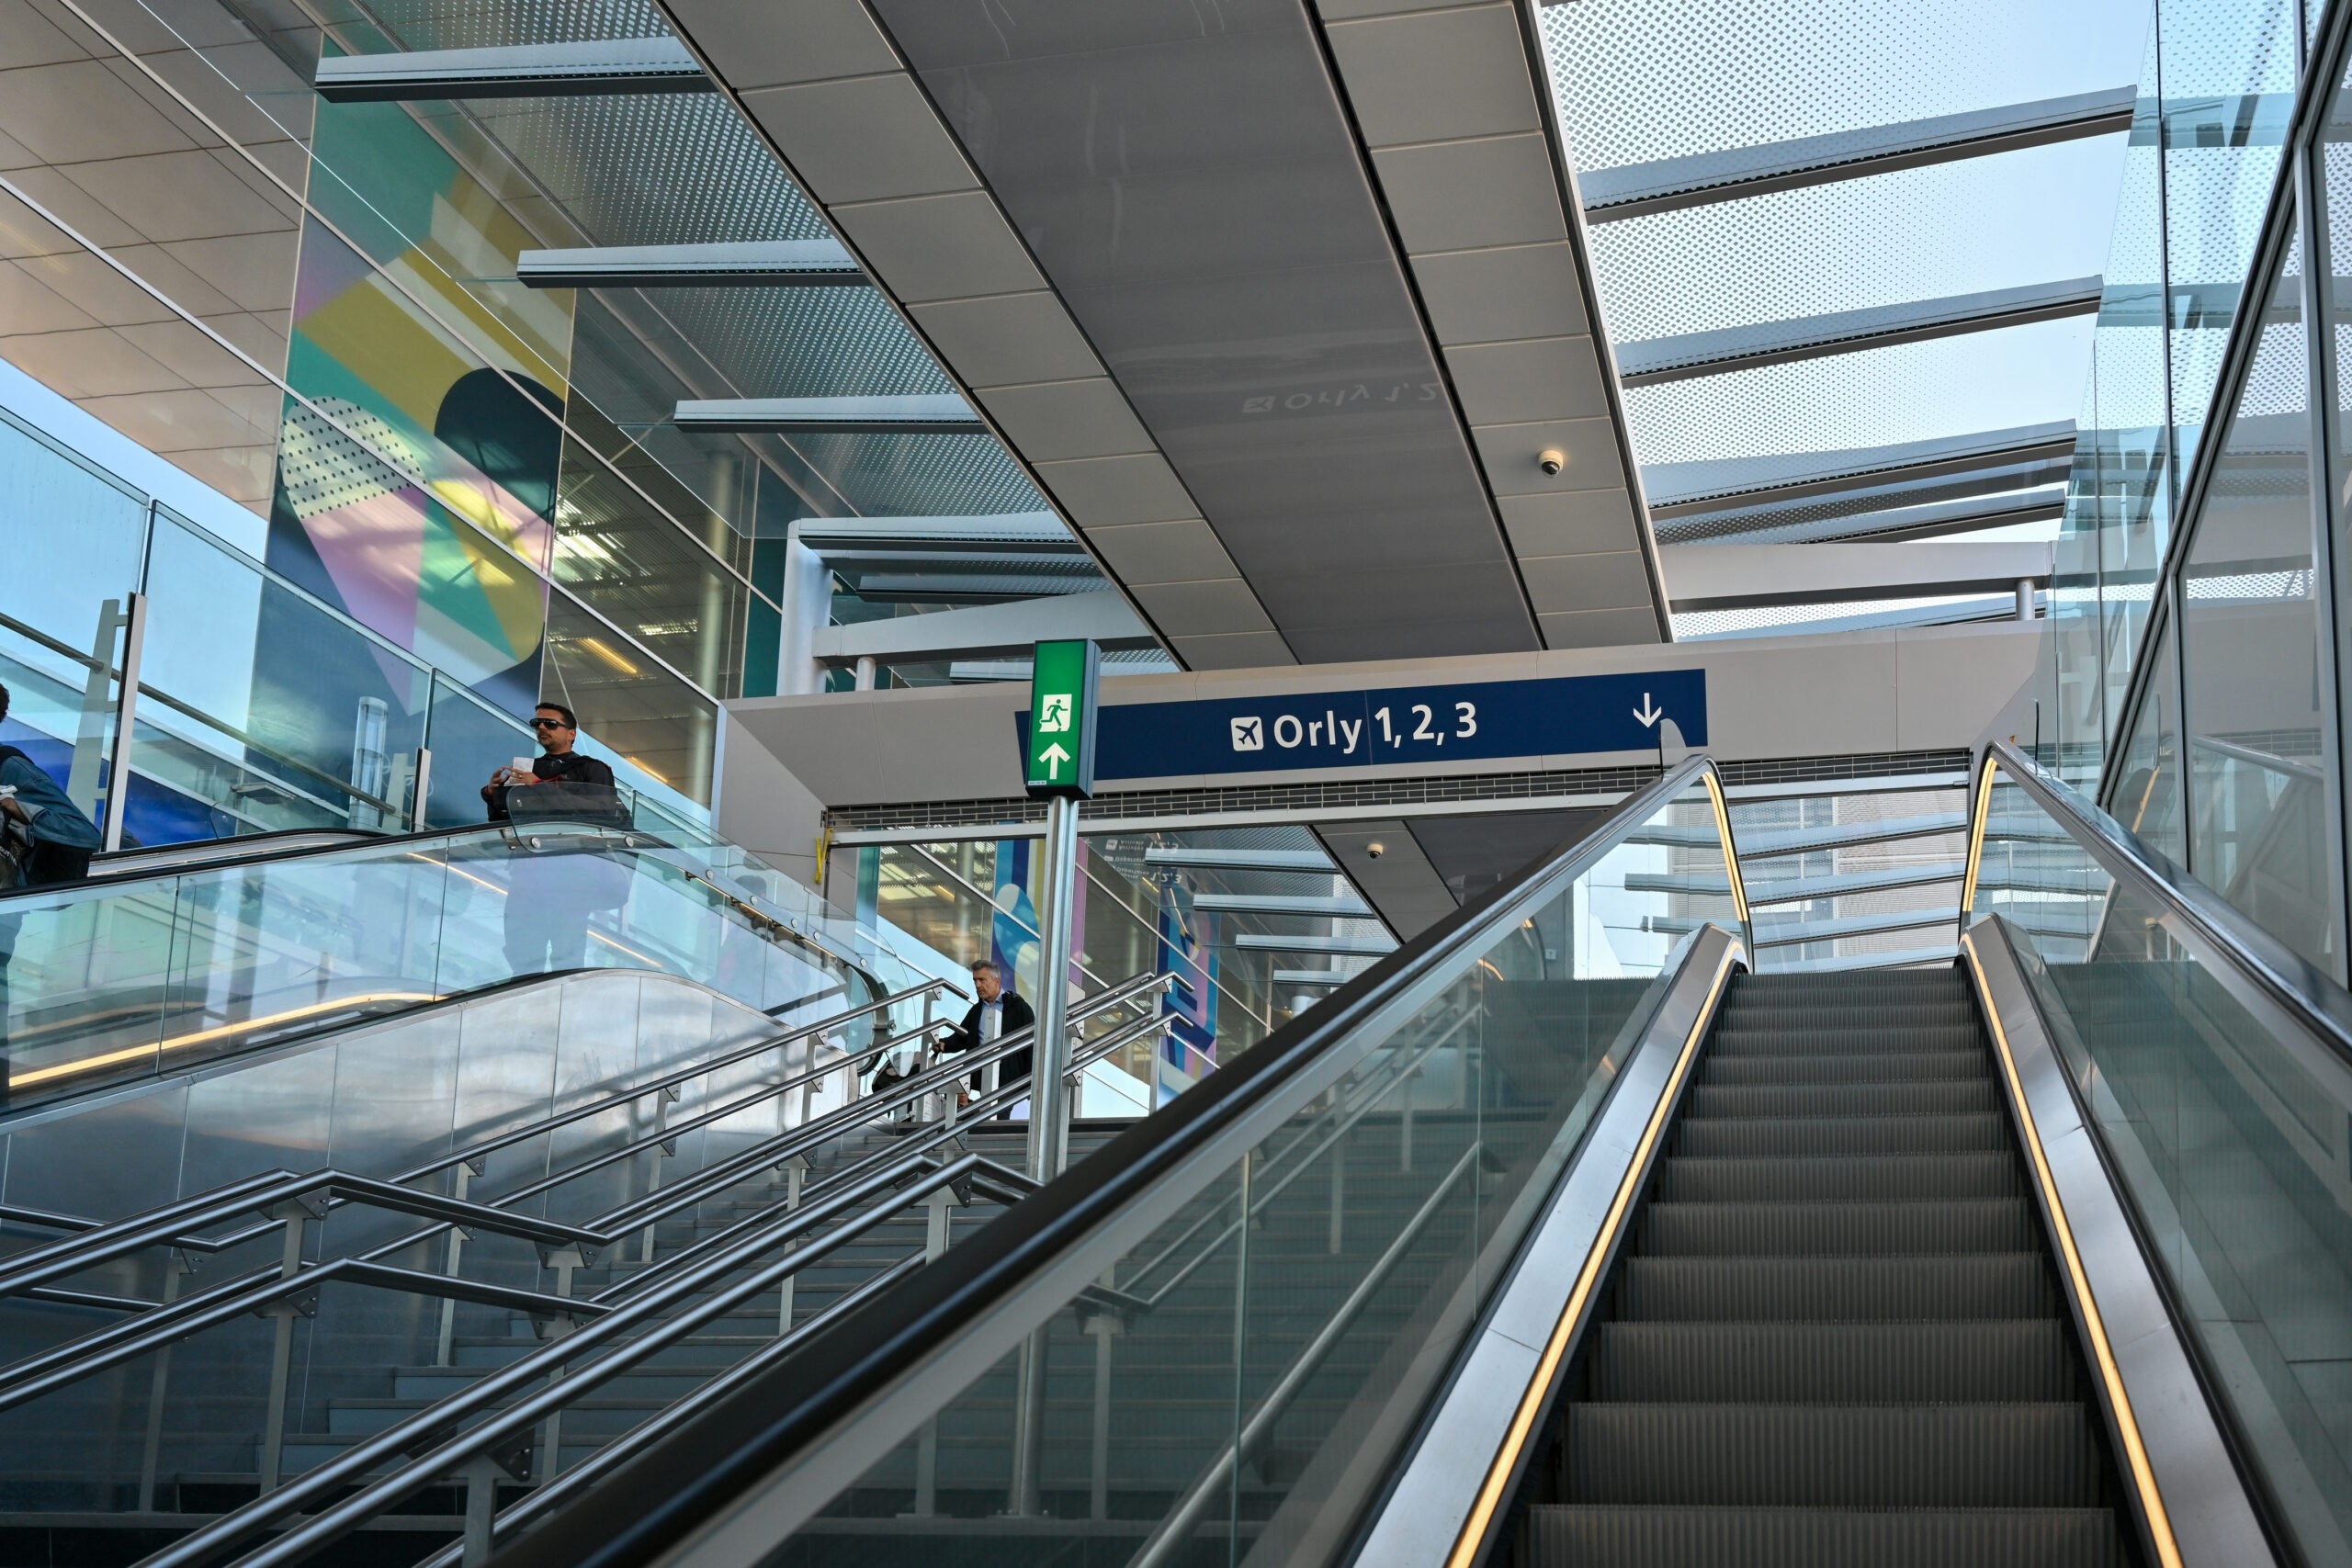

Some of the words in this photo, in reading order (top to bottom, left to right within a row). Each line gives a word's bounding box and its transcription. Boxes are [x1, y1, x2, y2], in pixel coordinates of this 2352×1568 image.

[1273, 710, 1363, 754] Orly
[1374, 706, 1402, 749] 1,
[1411, 704, 1444, 746] 2,
[1455, 701, 1477, 738] 3
